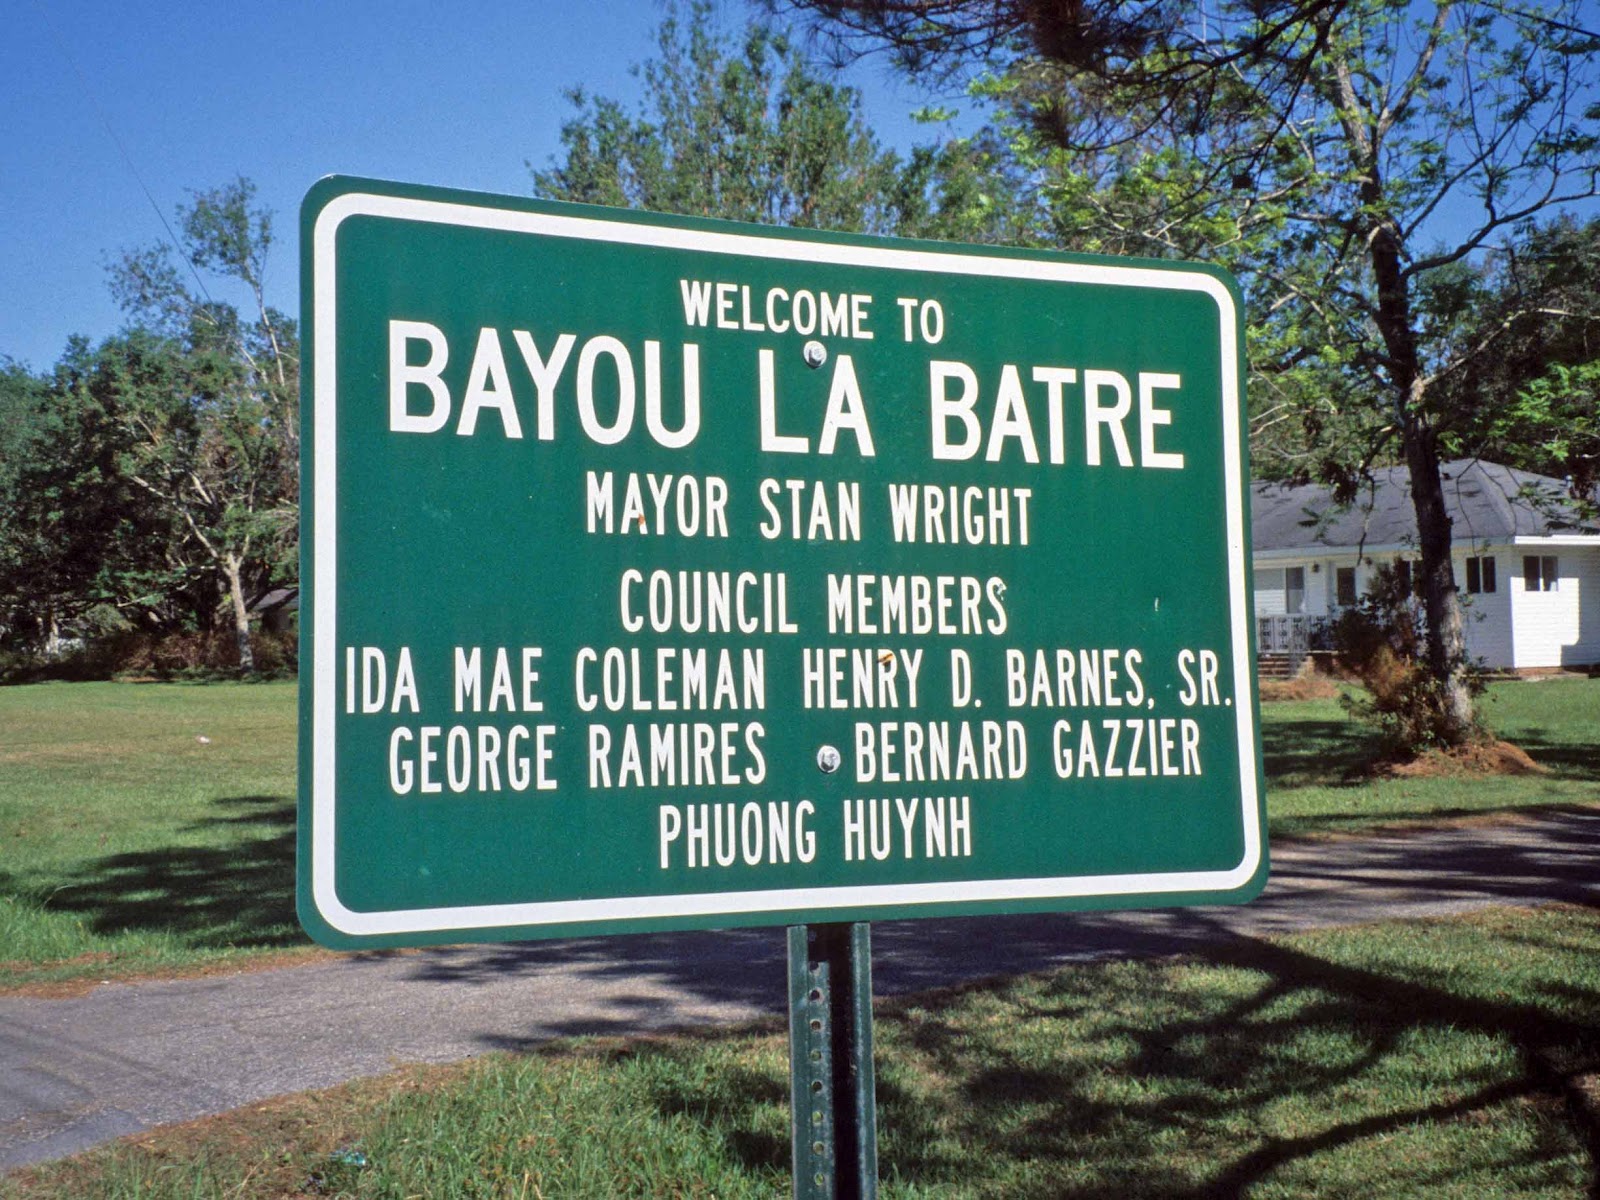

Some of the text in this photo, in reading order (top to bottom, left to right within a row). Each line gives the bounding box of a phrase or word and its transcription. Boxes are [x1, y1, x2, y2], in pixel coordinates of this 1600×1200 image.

[680, 279, 945, 345] WELCOME TO
[388, 319, 1185, 470] BAYOU LA BATRE
[586, 470, 1032, 546] MAYOR STAN WRIGHT
[620, 568, 1008, 636] COUNCIL MEMBERS
[346, 646, 1232, 714] IDA MAE COLEMAN HENRY D. BARNES, SR.
[389, 718, 1202, 795] GEORGE RAMIRES BERNARD GAZZIER
[659, 796, 972, 869] PHUONG HUYNH
